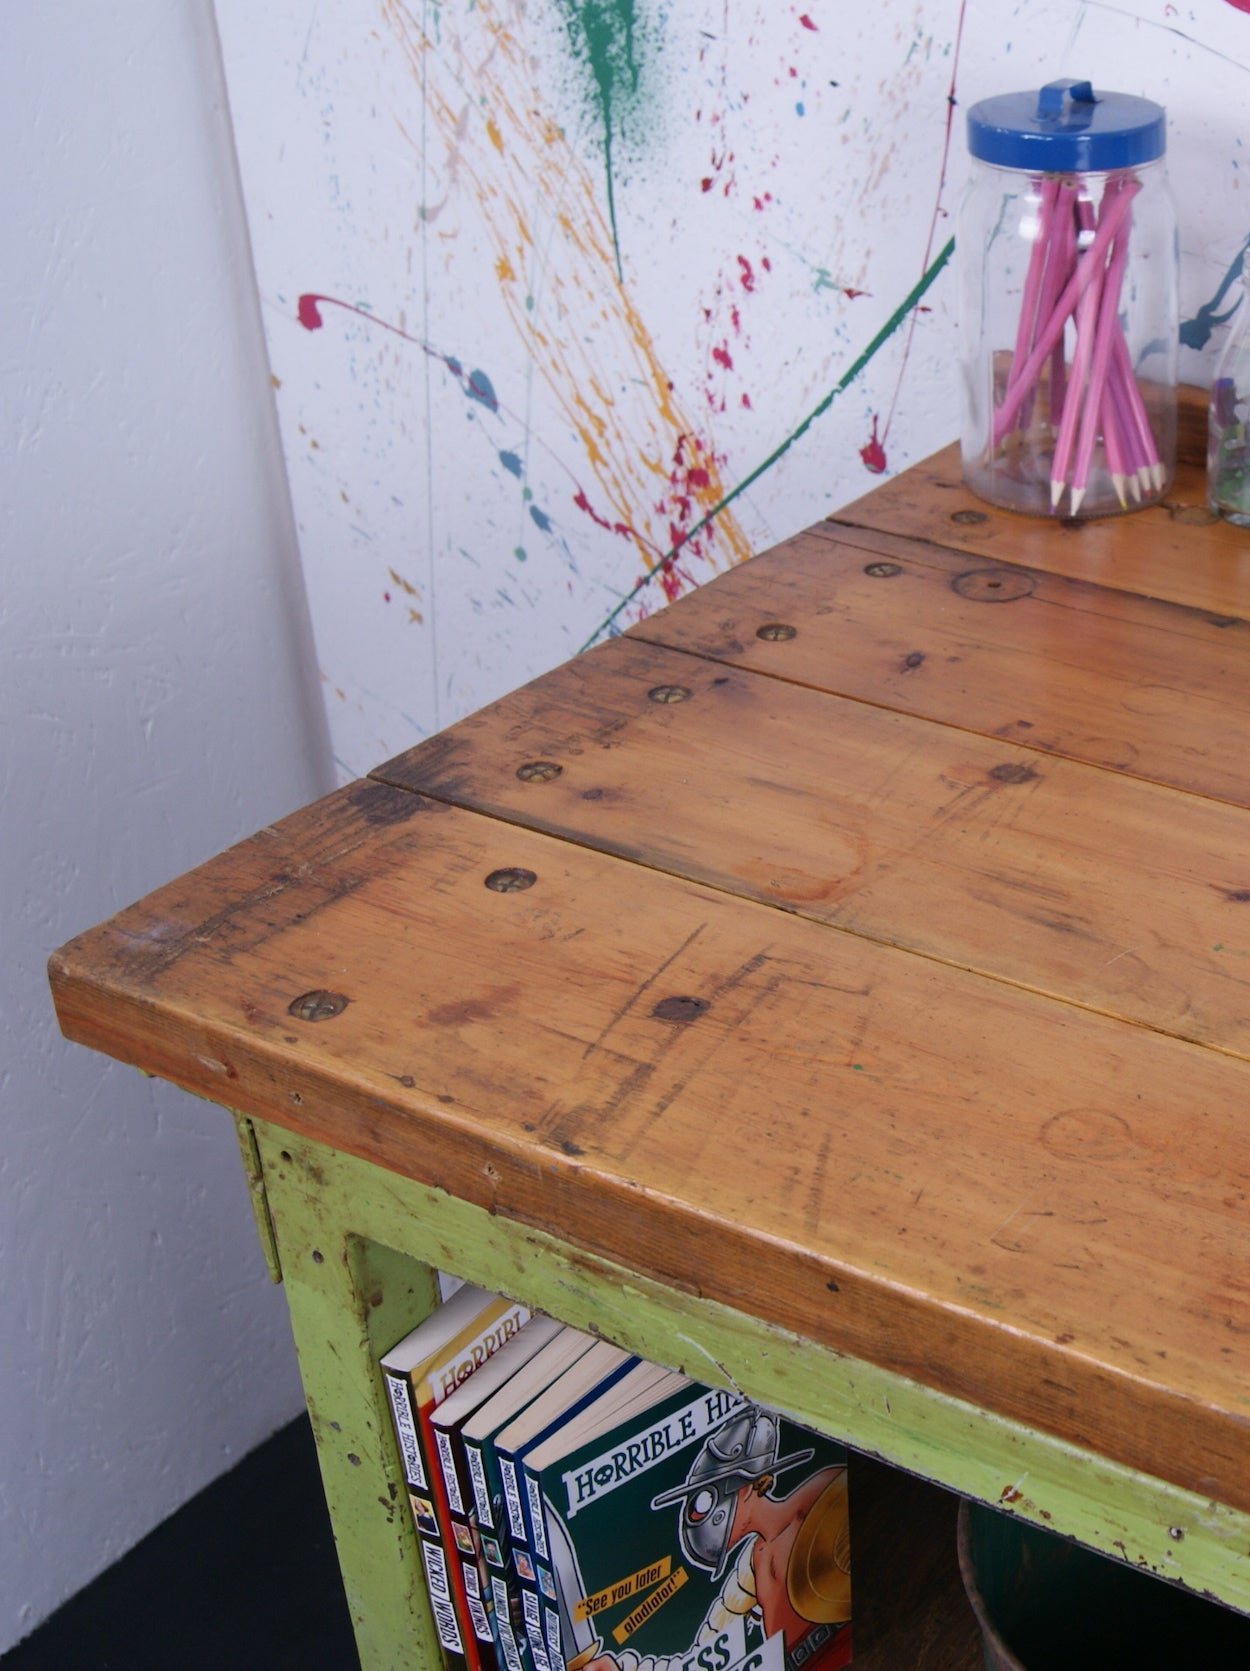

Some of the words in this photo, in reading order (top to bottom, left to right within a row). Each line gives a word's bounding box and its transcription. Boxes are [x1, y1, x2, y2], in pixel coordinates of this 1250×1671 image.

[391, 1380, 411, 1429] HORRIBLE
[402, 1432, 422, 1484] HISTORIES
[575, 1409, 696, 1503] HORRIBLE
[704, 1391, 743, 1426] HI
[425, 1545, 447, 1594] WICKED
[611, 1581, 632, 1604] you
[635, 1565, 662, 1590] later
[433, 1600, 460, 1648] WORDS
[470, 1600, 490, 1637] VIKINGS
[524, 1592, 540, 1624] SAVAGE
